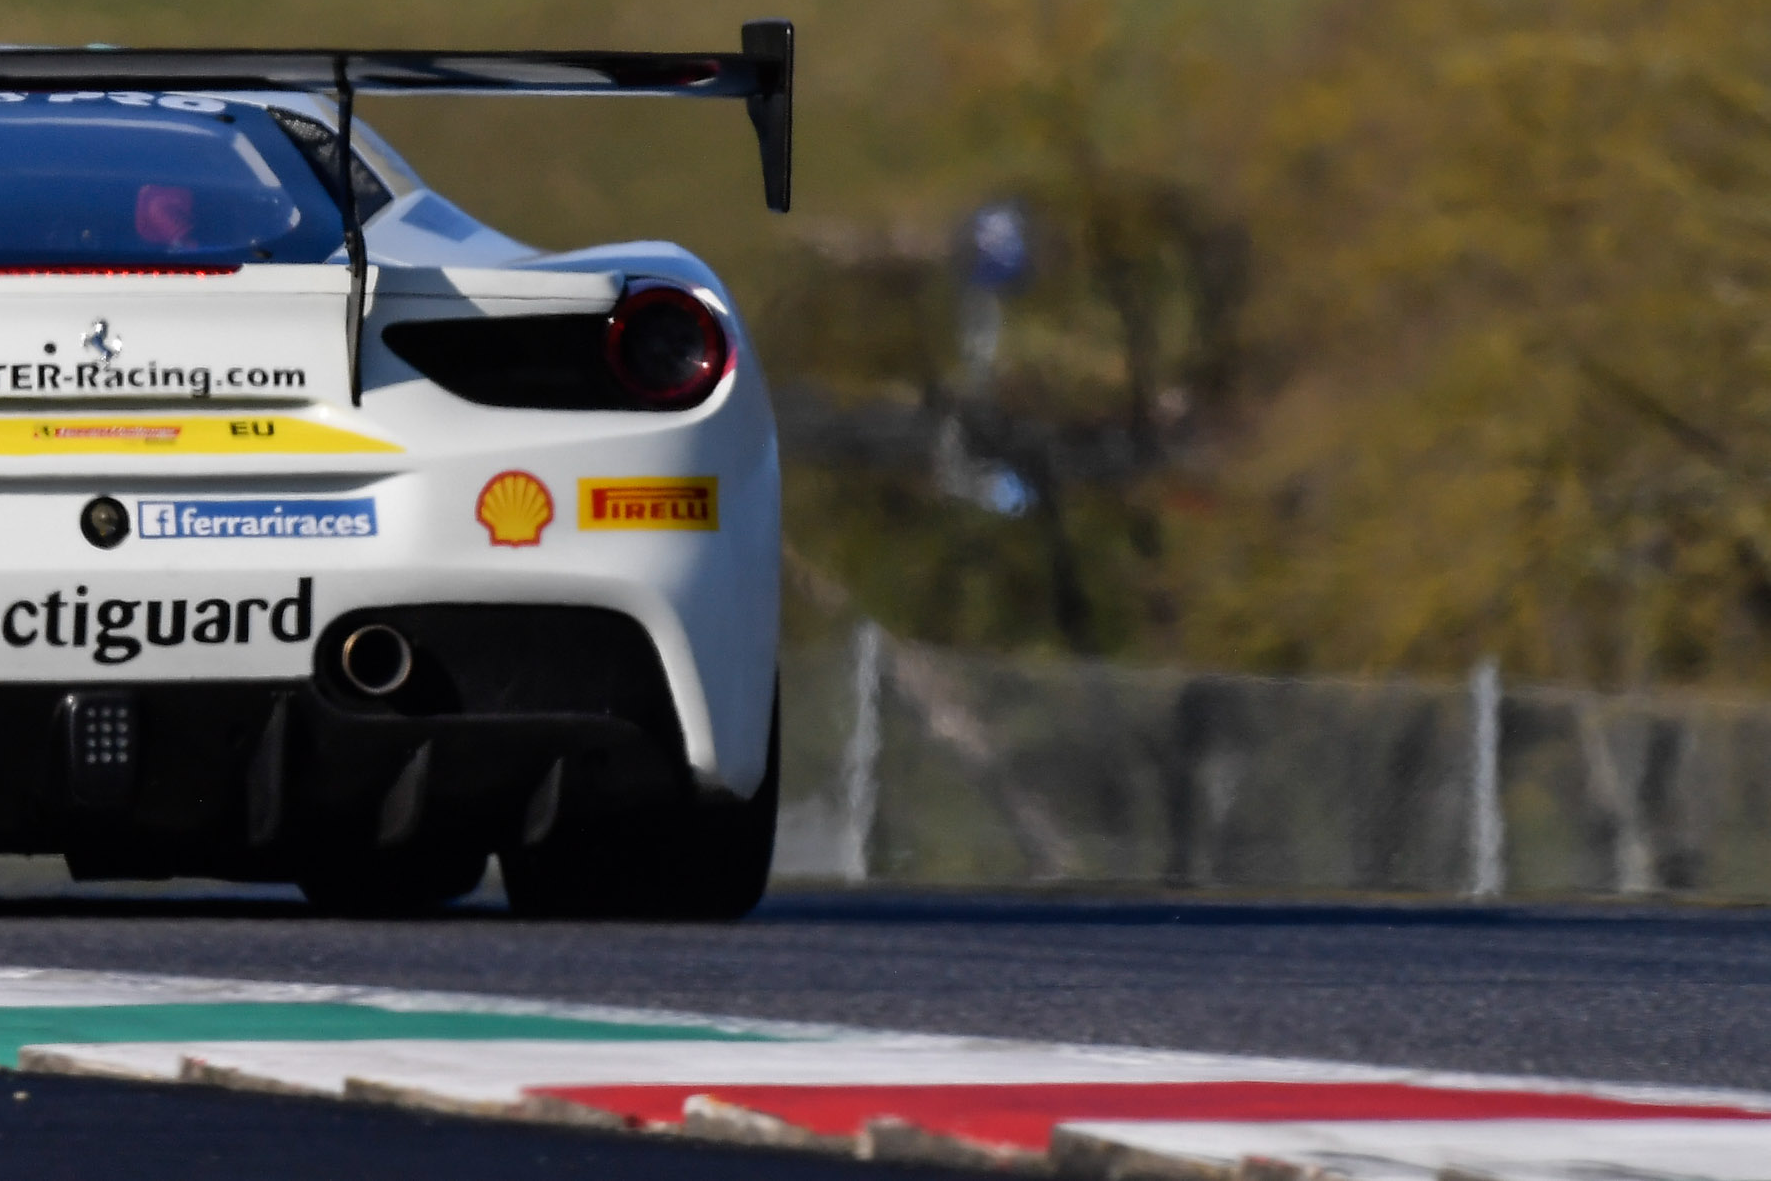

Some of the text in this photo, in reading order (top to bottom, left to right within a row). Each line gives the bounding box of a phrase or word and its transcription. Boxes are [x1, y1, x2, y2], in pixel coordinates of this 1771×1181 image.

[230, 421, 275, 436] EU
[592, 487, 708, 520] PIRELLI
[181, 506, 372, 535] ferrariraces
